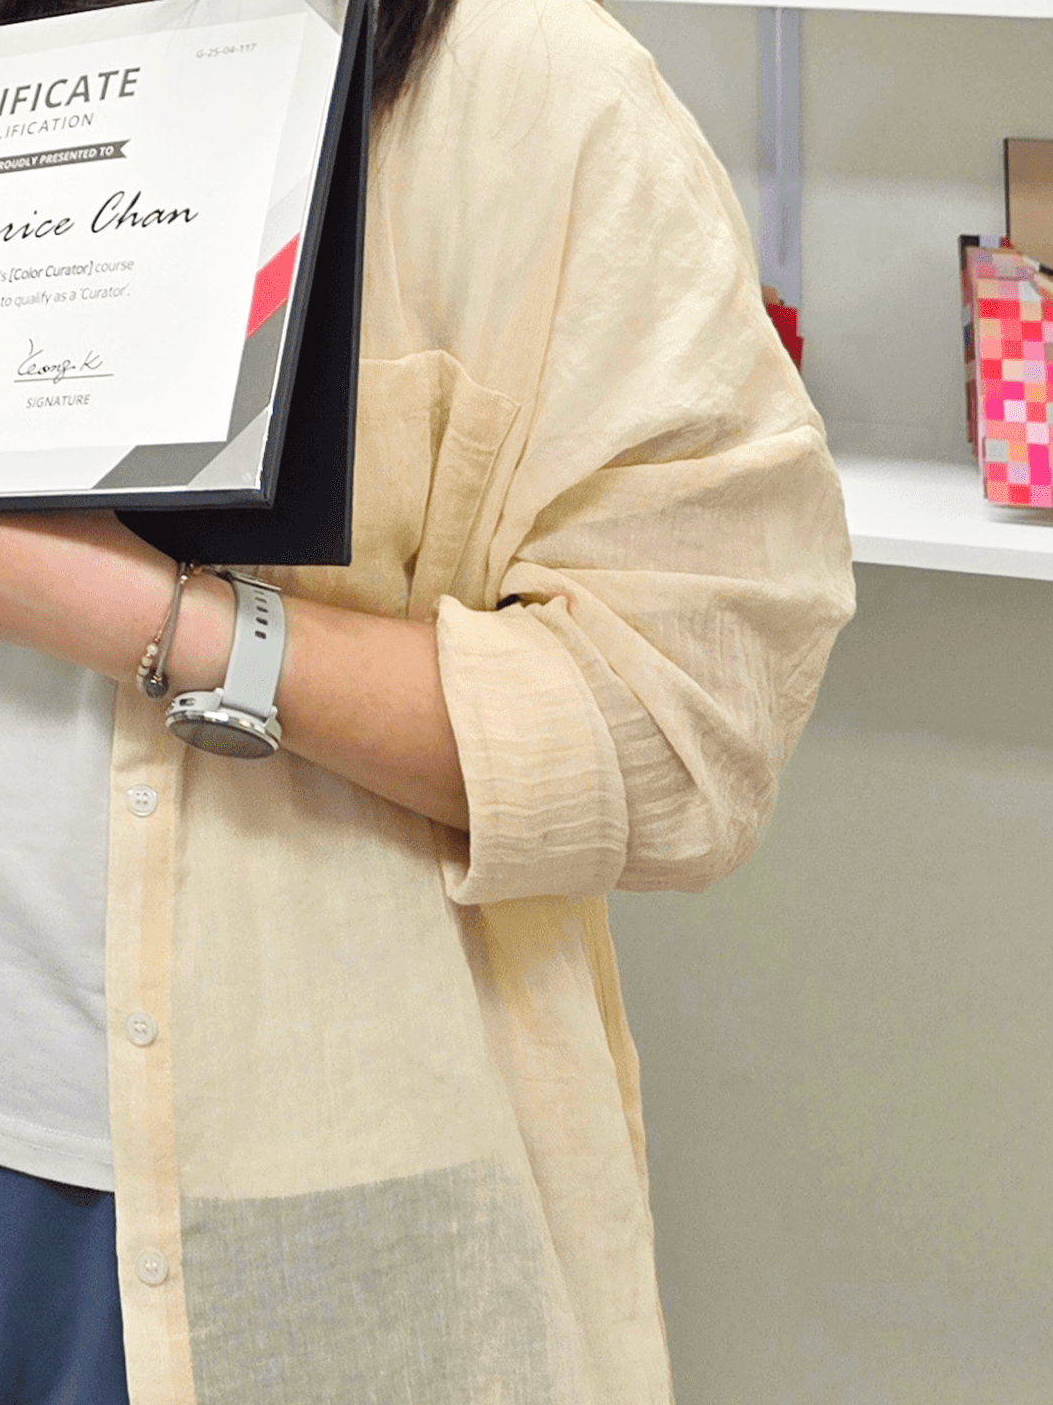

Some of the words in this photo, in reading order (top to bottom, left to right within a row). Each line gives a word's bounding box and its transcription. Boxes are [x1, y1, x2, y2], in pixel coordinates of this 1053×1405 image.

[38, 149, 97, 166] PRESENTED
[98, 145, 115, 157] TO
[91, 190, 199, 234] Chan
[8, 267, 44, 284] [Color
[45, 260, 94, 278] Curator]
[94, 260, 135, 274] course
[0, 295, 13, 308] to
[13, 290, 52, 308] qualify
[53, 292, 67, 303] as
[68, 290, 77, 302] a
[26, 394, 91, 409] SIGNATURE
